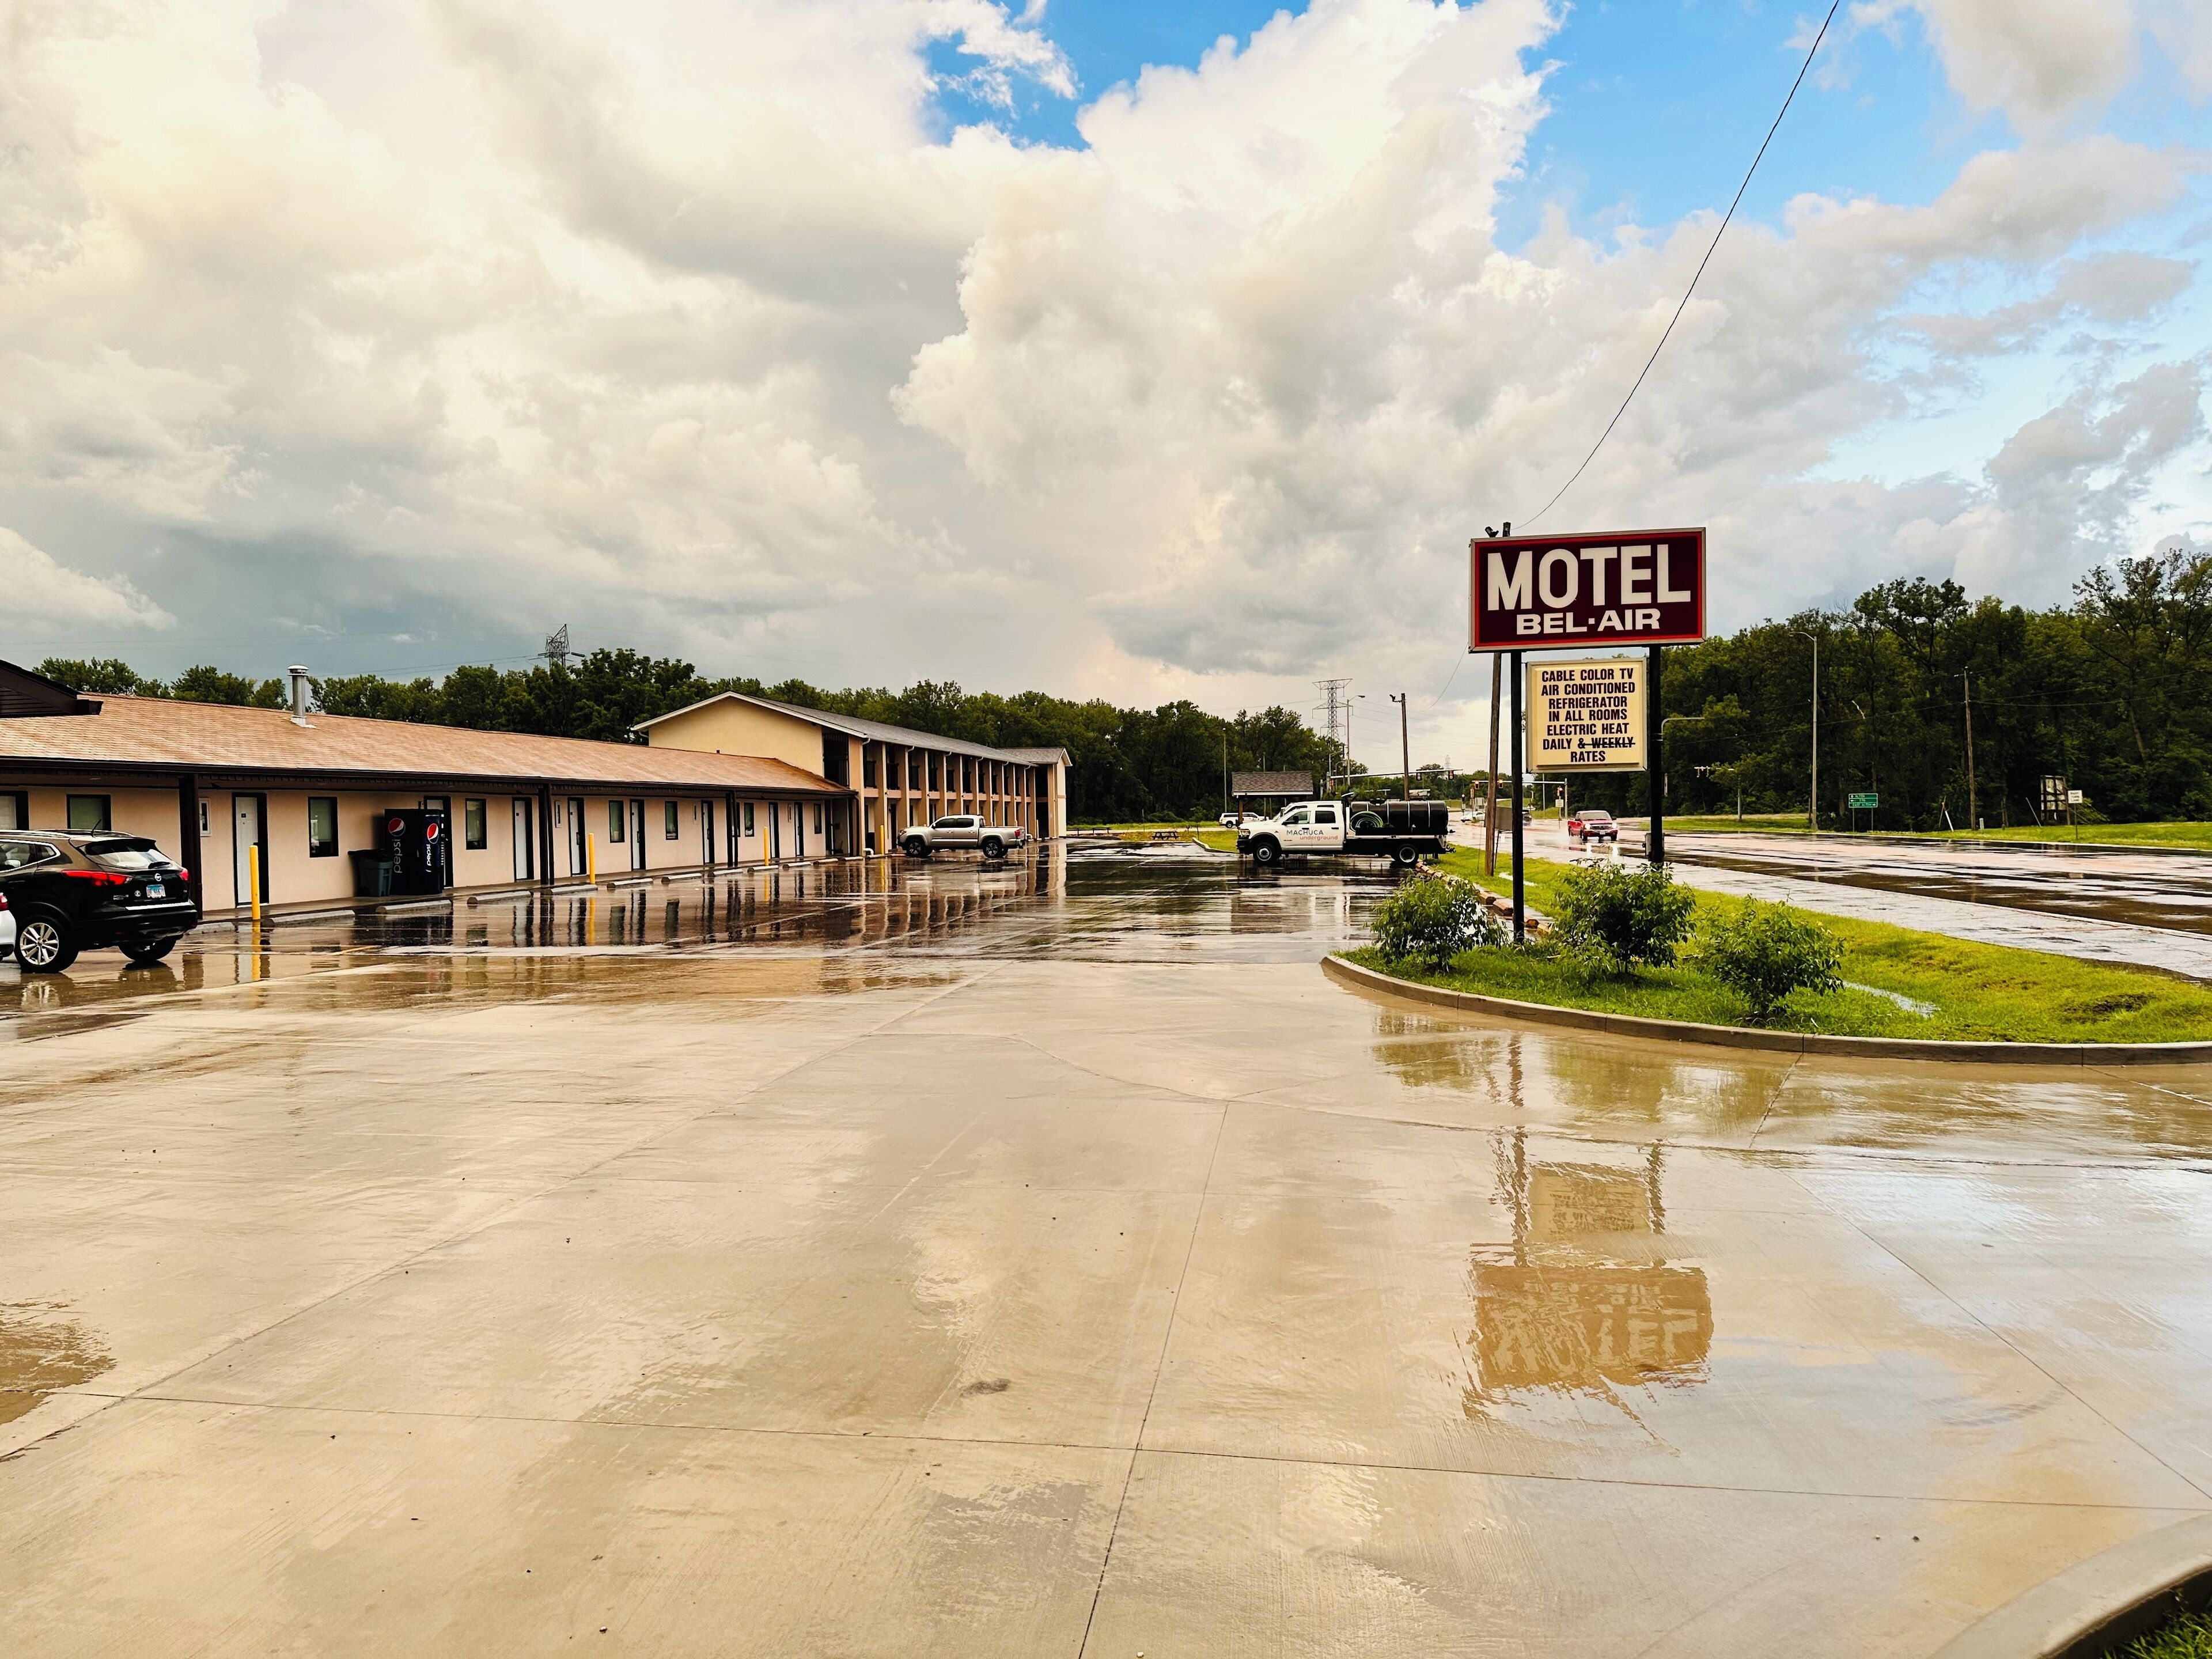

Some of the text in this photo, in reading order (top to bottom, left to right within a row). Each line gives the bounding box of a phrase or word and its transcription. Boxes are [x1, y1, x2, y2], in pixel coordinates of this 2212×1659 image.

[1488, 544, 1691, 611] MOTEL
[1542, 668, 1634, 682] CABLE COLOR TV
[1541, 682, 1635, 696] AIR CONDITIONED
[1549, 696, 1627, 709] REFRIGERATOR
[1549, 709, 1627, 722] IN ALL ROOMS
[1547, 723, 1629, 736] ELECTRIC HEAT
[1543, 737, 1634, 749] DAILY & WEEKLY
[1571, 751, 1605, 762] RATES
[392, 839, 402, 873] pepsi
